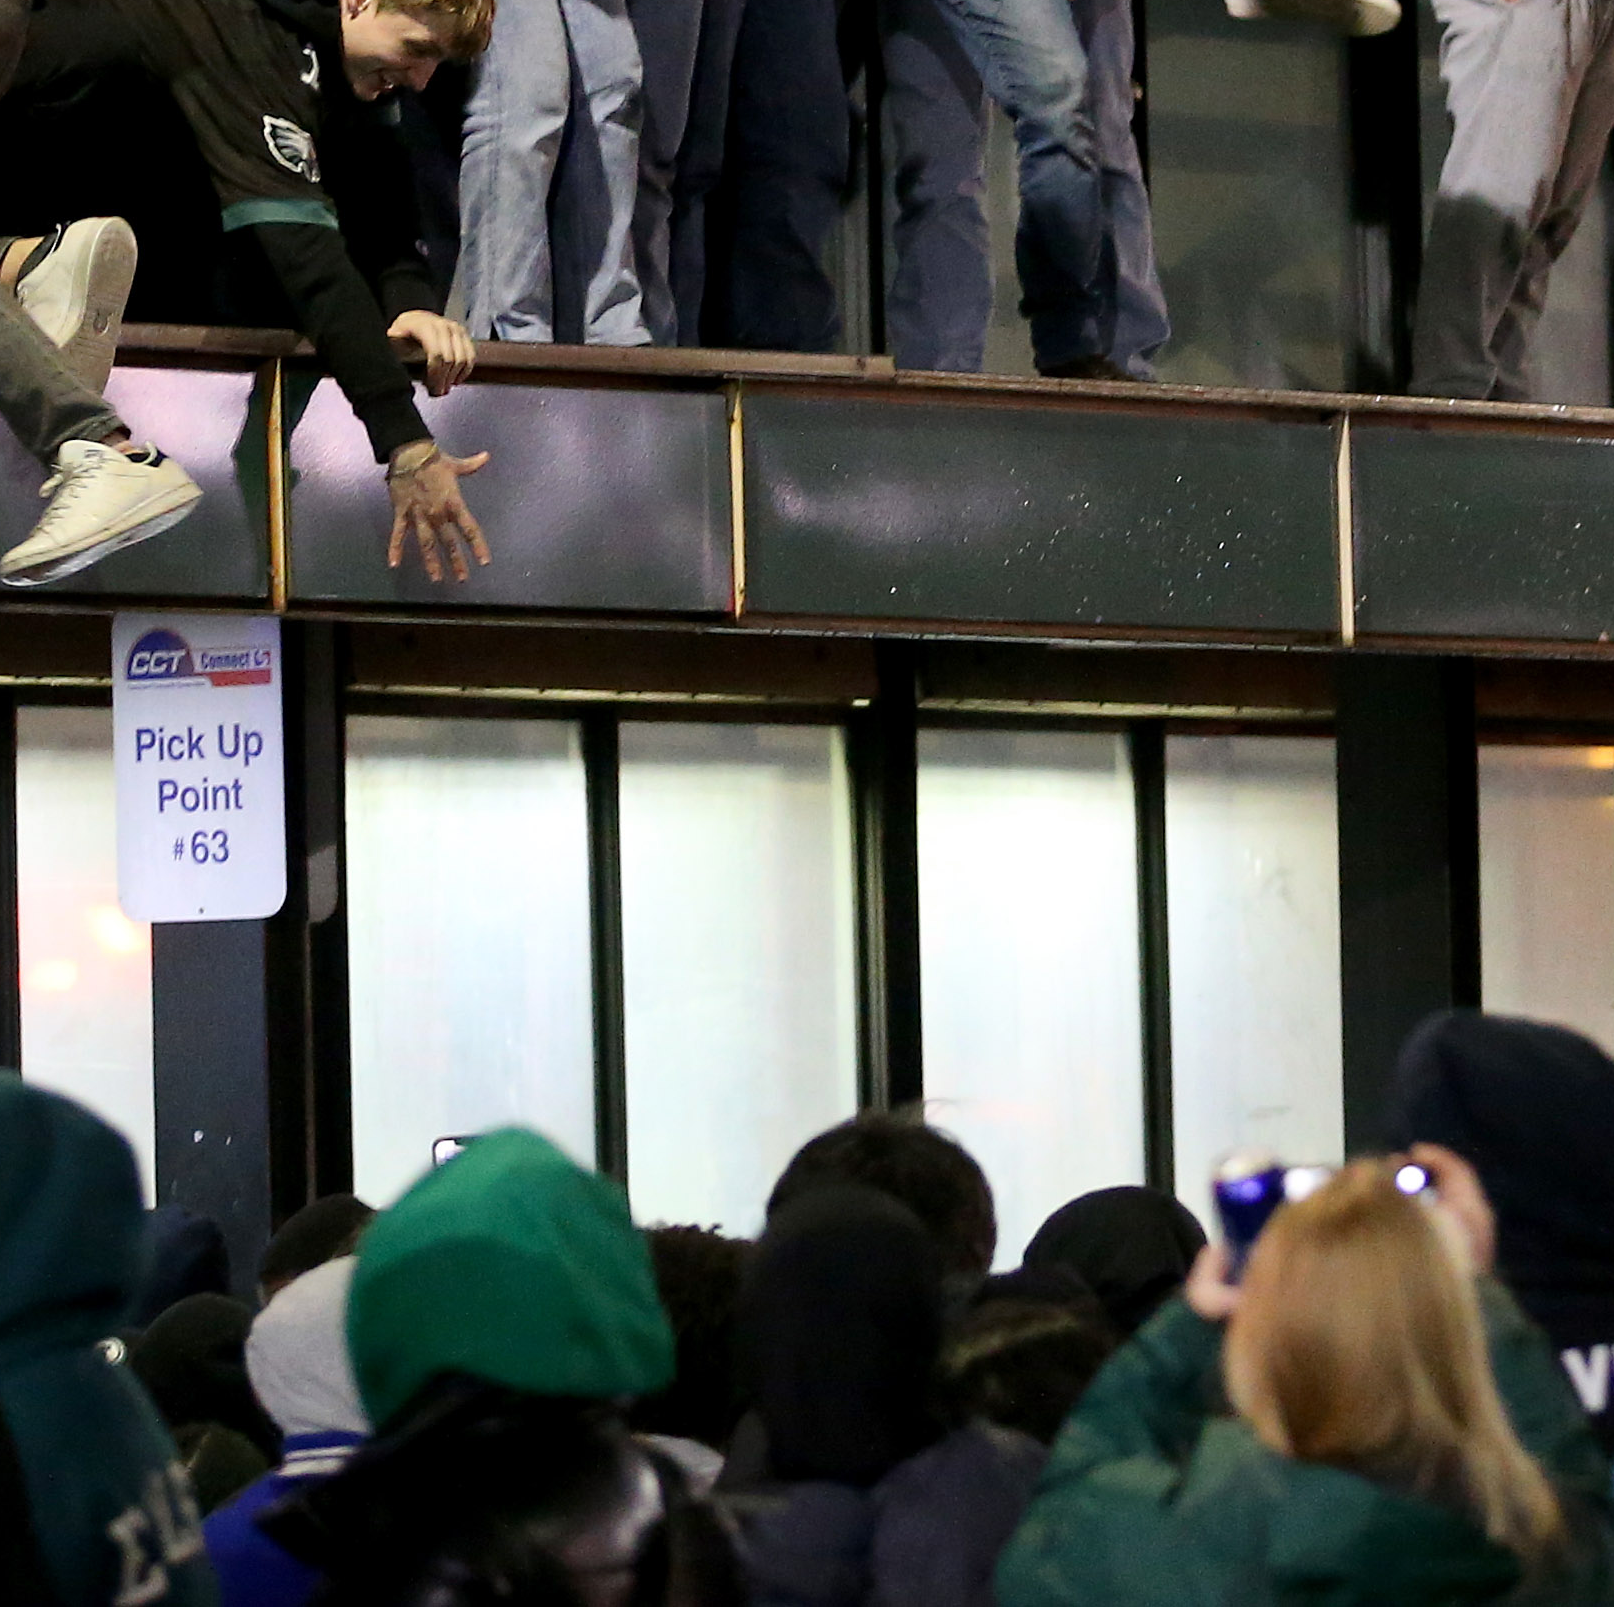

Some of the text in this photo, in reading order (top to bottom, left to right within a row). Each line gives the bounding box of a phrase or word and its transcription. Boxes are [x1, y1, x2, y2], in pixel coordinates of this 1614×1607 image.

[129, 648, 250, 676] CCT Connect
[136, 722, 263, 767] Pick Up
[158, 776, 243, 813] Point
